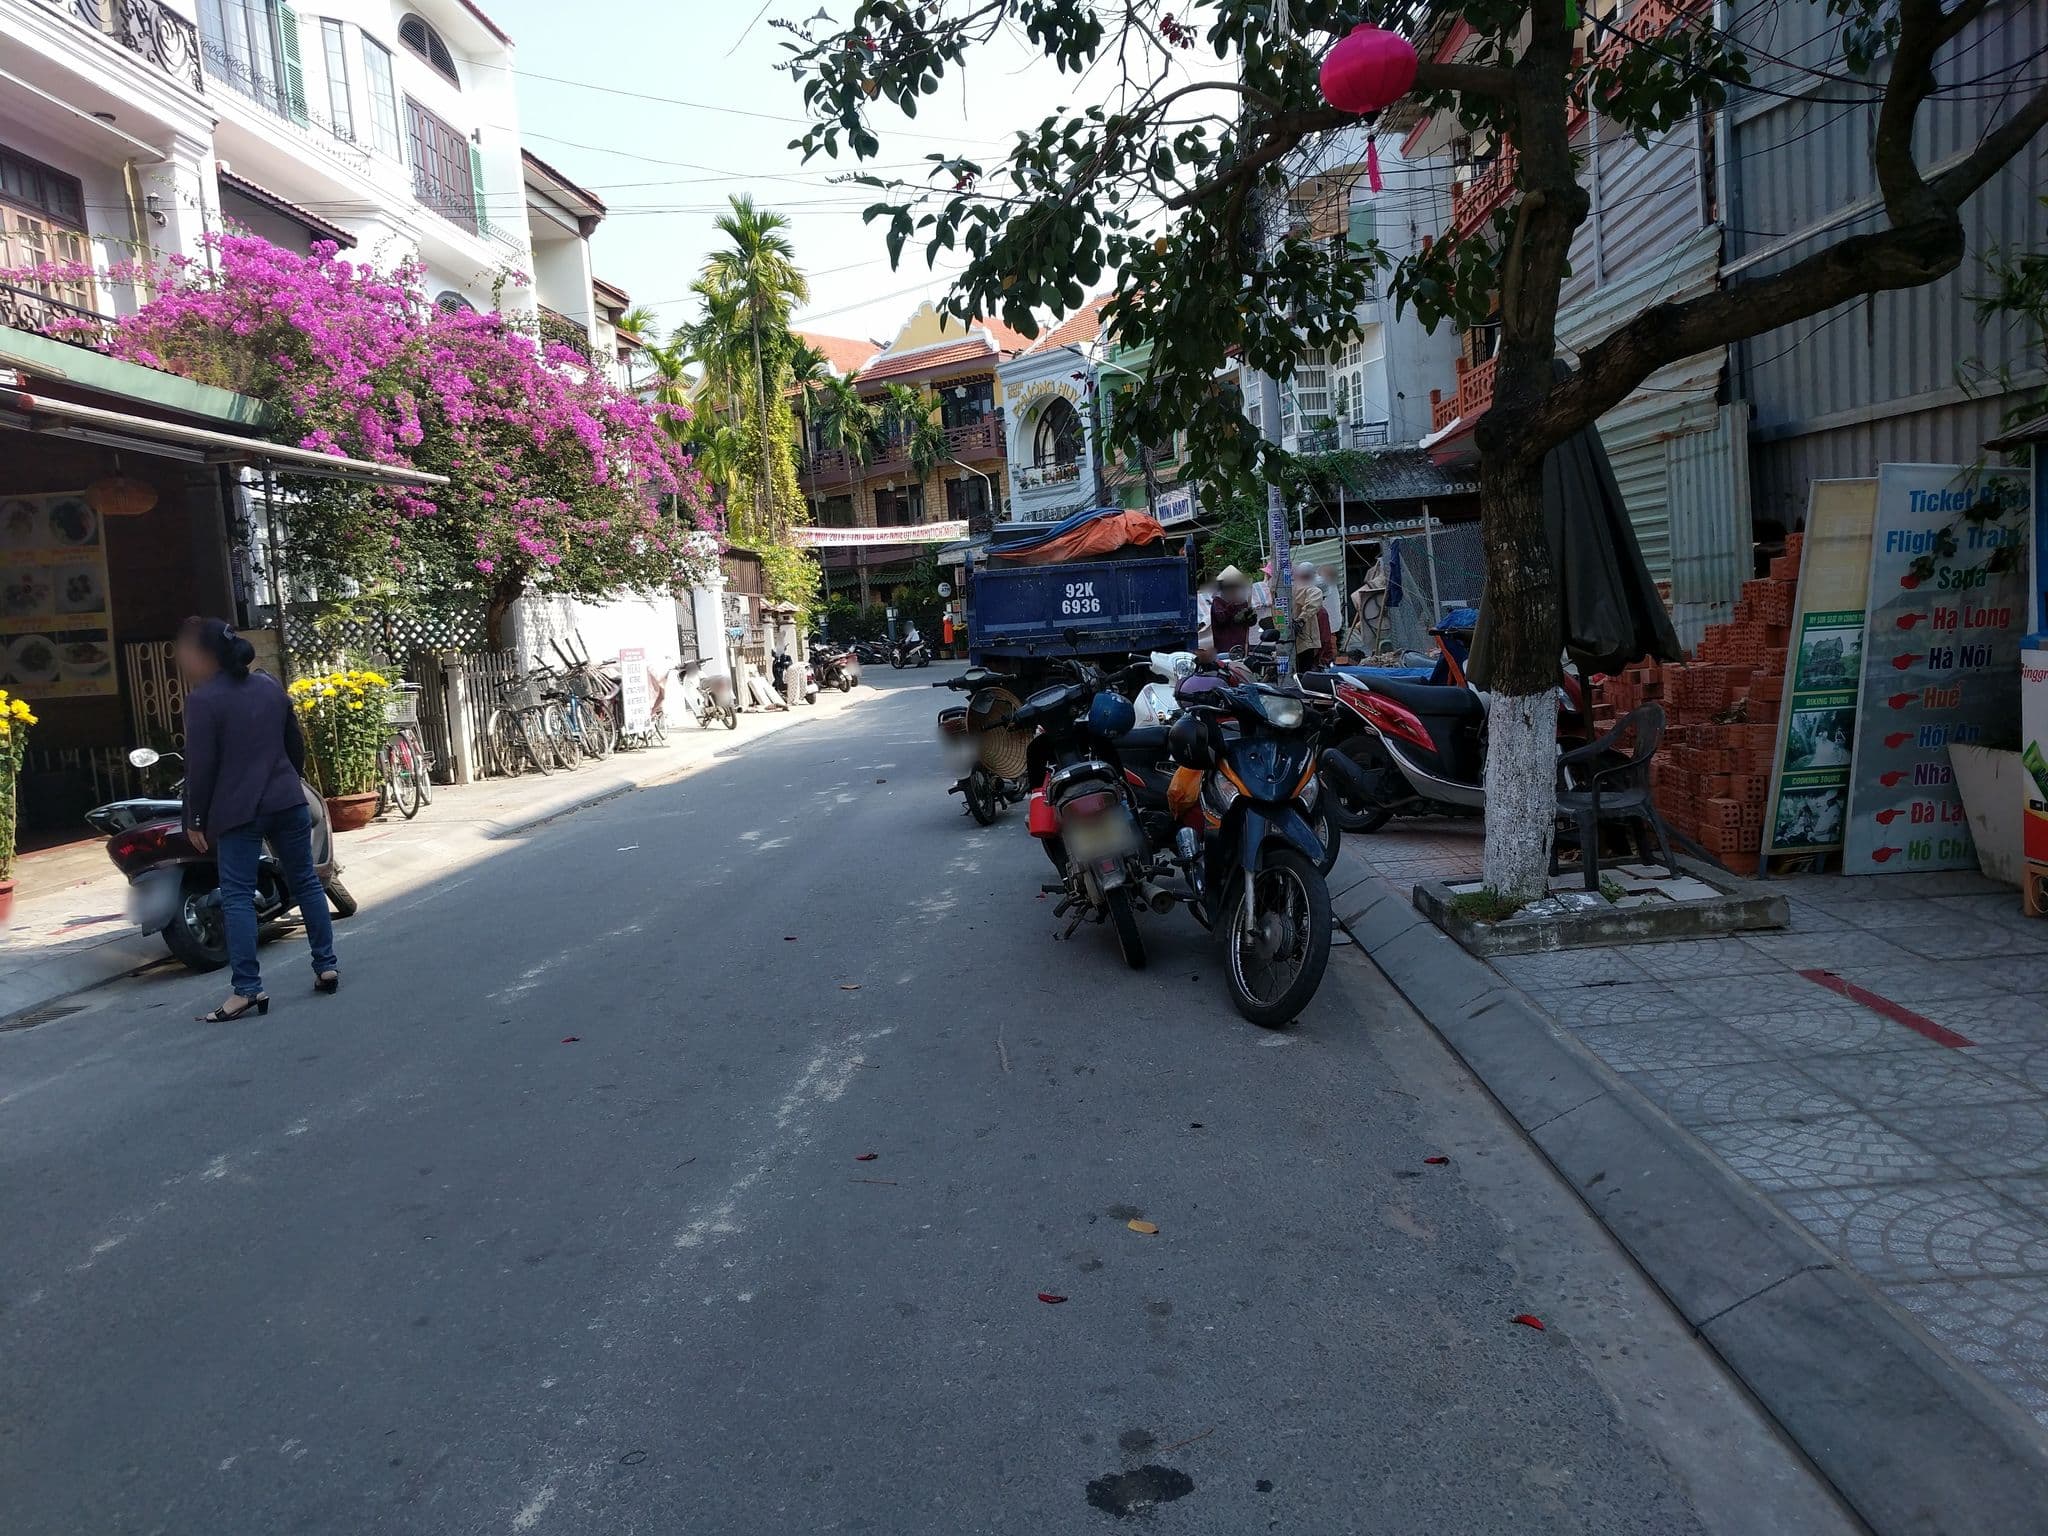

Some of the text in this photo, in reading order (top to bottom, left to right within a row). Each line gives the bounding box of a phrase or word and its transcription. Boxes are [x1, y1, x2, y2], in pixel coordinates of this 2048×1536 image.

[1909, 487, 1973, 513] Ticket
[1065, 581, 1095, 599] 92K
[1937, 565, 1988, 591] Sapa
[1062, 598, 1100, 615] 6936
[1933, 605, 2011, 635] Hạ Long
[1928, 643, 1993, 672] Hà Nội
[1829, 696, 1850, 704] TOURS
[1923, 680, 1962, 708] Huế
[1919, 723, 1980, 752] Hội An
[1820, 775, 1841, 784] TOURS
[1914, 763, 1952, 787] Nha
